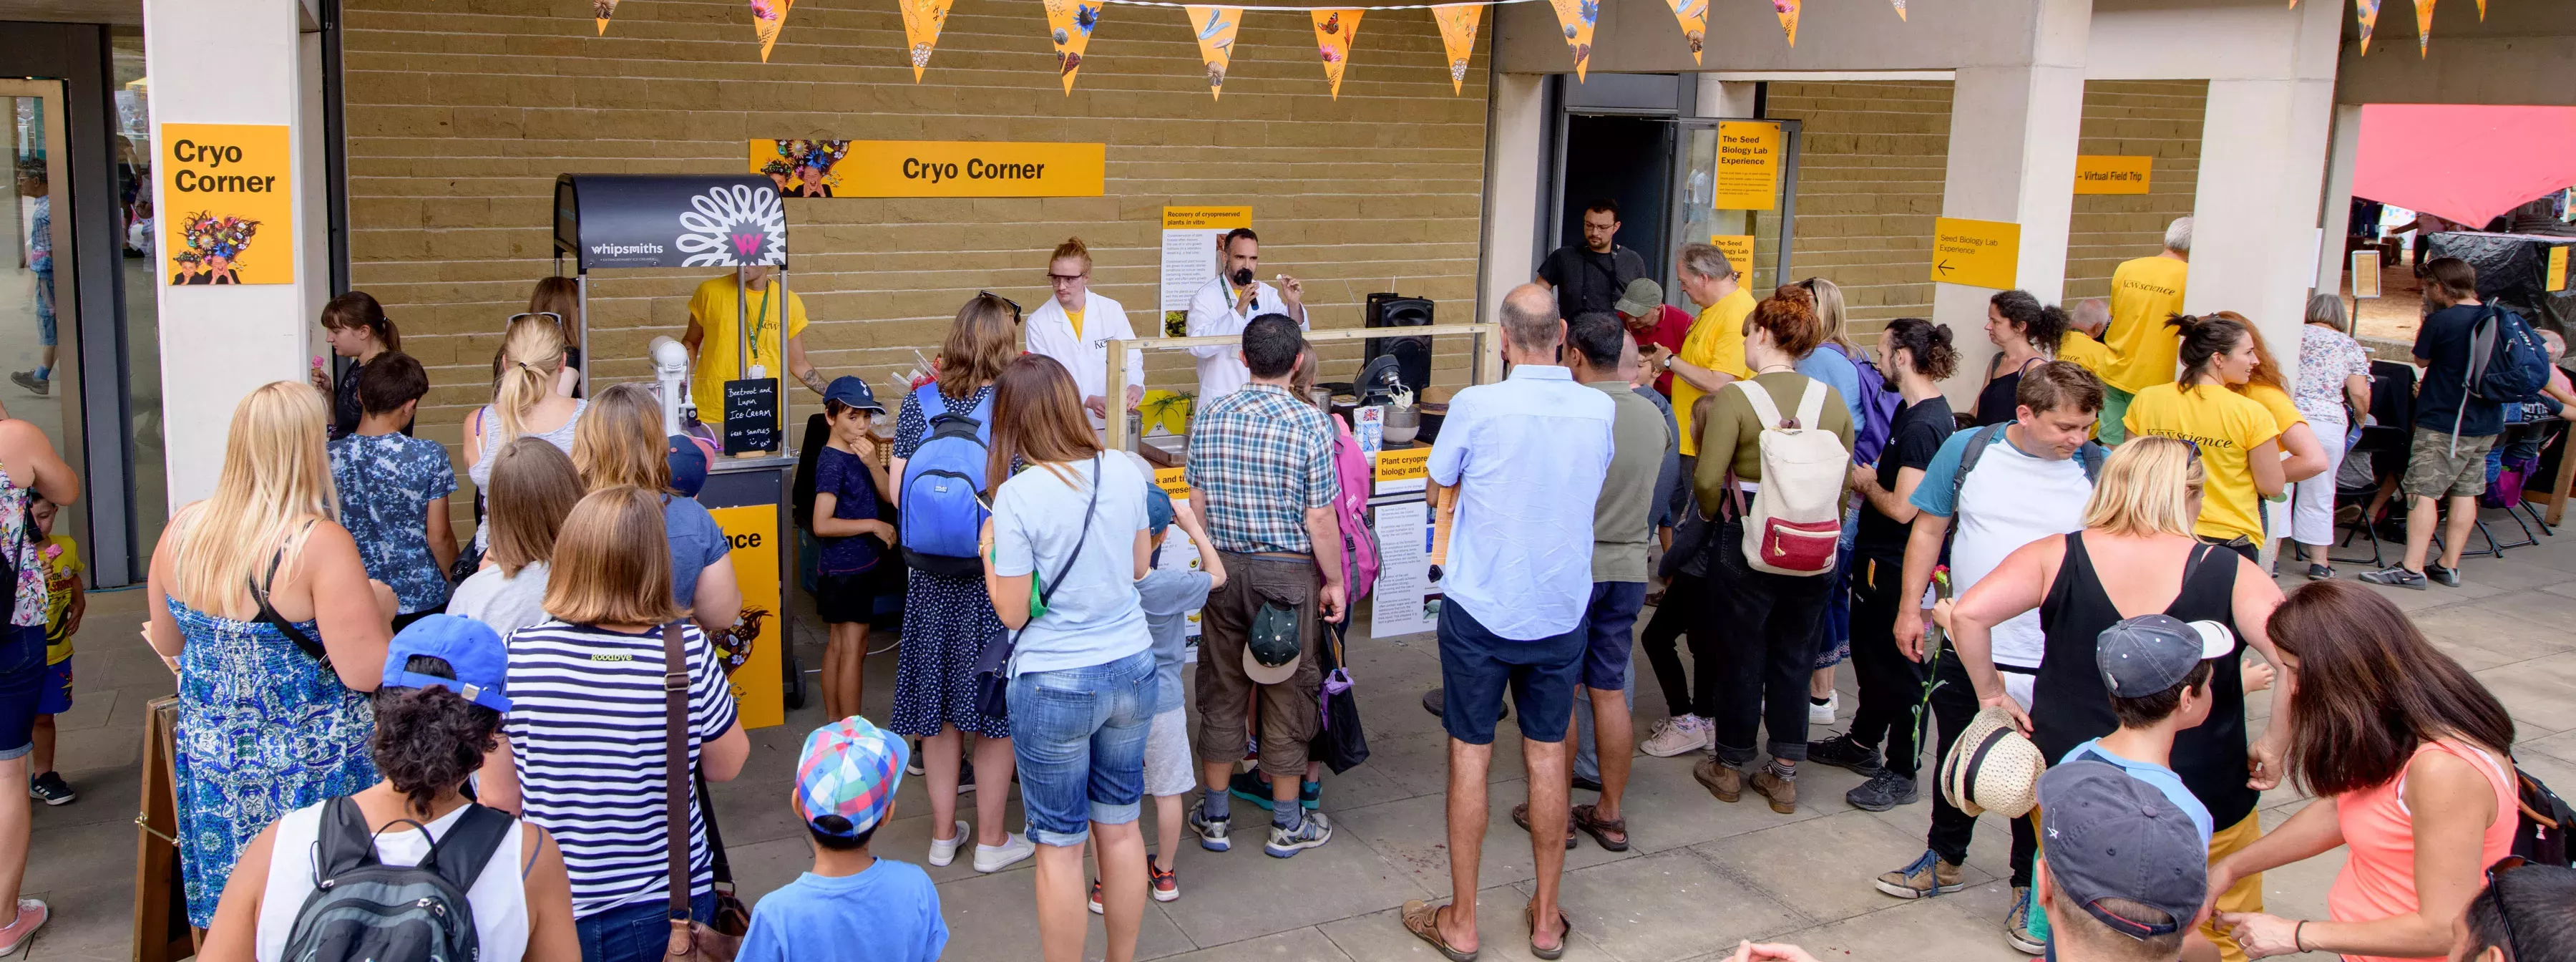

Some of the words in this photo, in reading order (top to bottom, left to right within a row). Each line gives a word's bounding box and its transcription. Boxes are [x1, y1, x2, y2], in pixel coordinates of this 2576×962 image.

[174, 139, 243, 168] Cryo
[1722, 146, 1751, 155] Biology
[1721, 157, 1765, 165] Experience
[903, 157, 958, 184] Cryo
[967, 158, 1045, 179] Corner
[175, 170, 275, 193] Corner
[2084, 171, 2108, 180] Virtual
[2110, 172, 2127, 180] Field
[2129, 172, 2142, 183] Trip
[1941, 234, 1957, 243] Seed
[1959, 236, 1984, 246] Biology
[591, 243, 663, 257] whipsmiths
[1939, 244, 1975, 254] Experience
[728, 387, 756, 397] Beetroot
[738, 397, 757, 406] Lupin
[729, 410, 744, 420] ICE
[746, 409, 771, 417] CREAM
